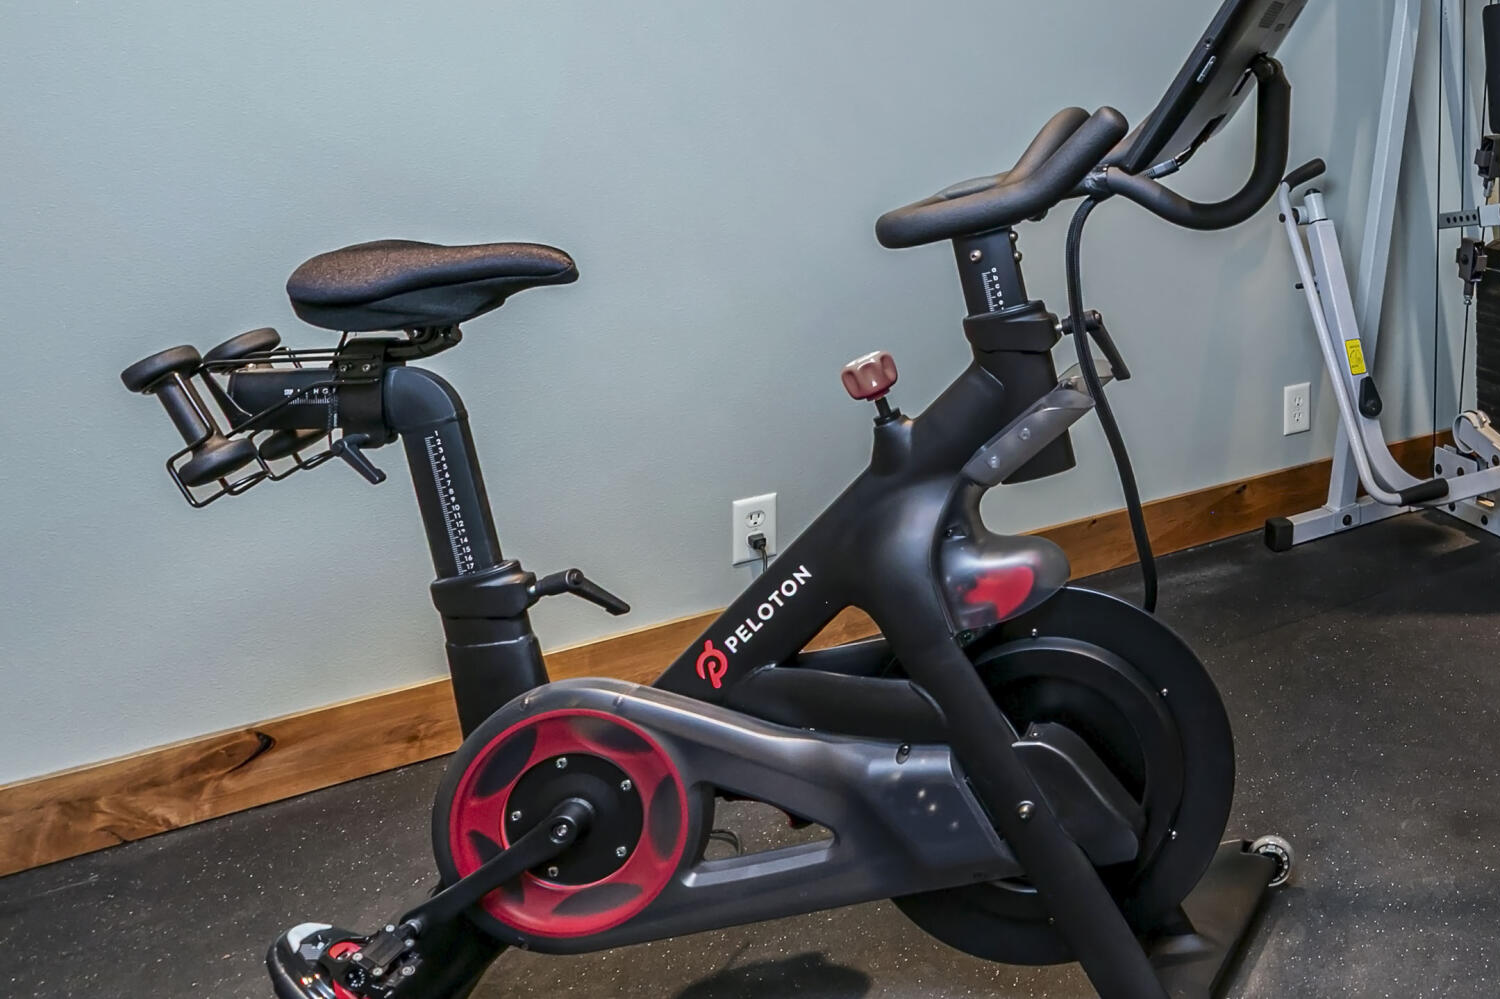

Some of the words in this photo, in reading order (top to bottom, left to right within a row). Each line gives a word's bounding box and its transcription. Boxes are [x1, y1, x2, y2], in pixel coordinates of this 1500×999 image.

[451, 503, 461, 511] 10
[453, 512, 462, 520] 11
[455, 519, 465, 528] 12
[459, 536, 469, 545] 14
[462, 545, 472, 554] 15
[464, 554, 474, 562] 16
[466, 562, 475, 570] 17
[725, 564, 812, 653] PELOTON
